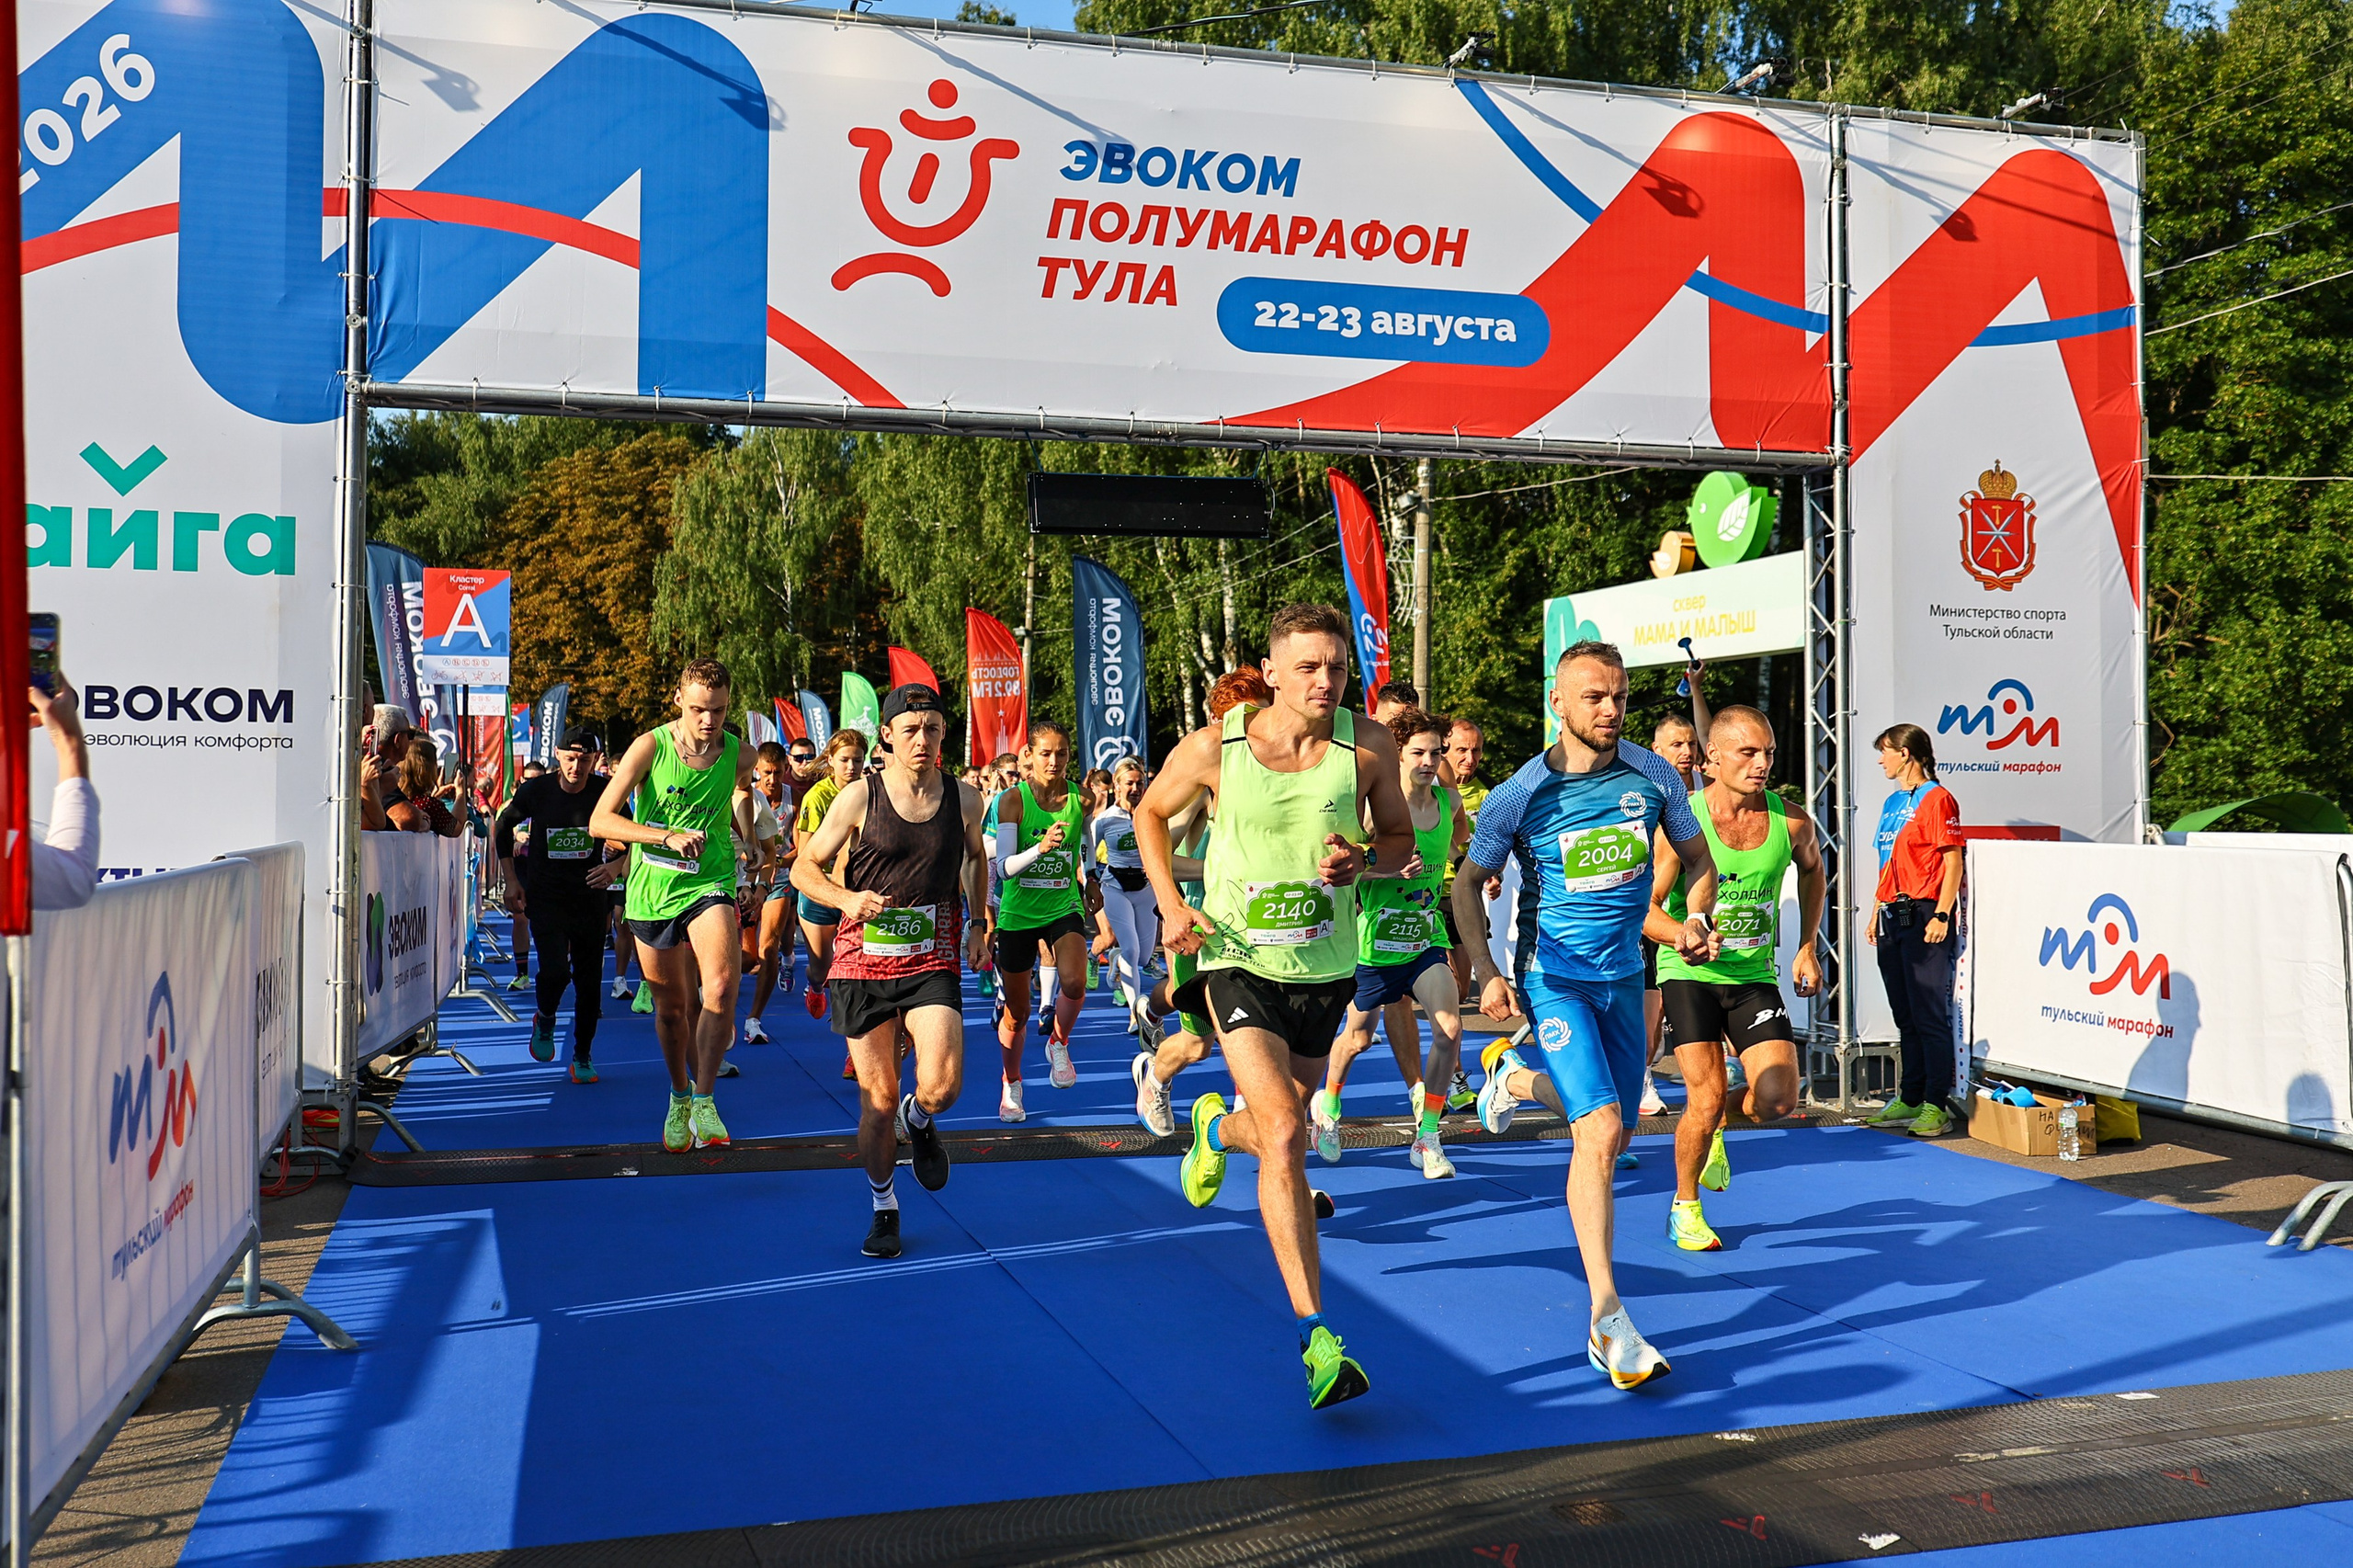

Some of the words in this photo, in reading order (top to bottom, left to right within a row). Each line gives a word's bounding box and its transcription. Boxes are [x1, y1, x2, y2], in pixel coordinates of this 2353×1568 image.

[1060, 140, 1302, 199] ЭВОКОМ
[1046, 198, 1470, 268] ПОЛУМАРАФОН
[1037, 256, 1179, 308] ТУЛА
[1255, 300, 1362, 337] 22-23
[1370, 314, 1518, 345] августа
[449, 574, 485, 585] Кластер
[1929, 605, 2021, 619] Министерство
[2023, 609, 2066, 623] спорта
[1633, 623, 1677, 647] МАМА
[1694, 610, 1756, 638] МАЛЫШ
[1943, 625, 2001, 640] Тульской
[2003, 627, 2054, 640] области
[84, 733, 188, 748] эволюция
[194, 733, 293, 751] комфорта
[539, 701, 553, 768] ЭВОКОМ
[1938, 760, 2000, 774] тульский
[2003, 761, 2062, 773] марафон
[556, 837, 585, 847] 2034
[1578, 843, 1633, 868] 2004
[1029, 861, 1063, 875] 2058
[1597, 864, 1617, 873] СЕРГЕЙ
[1262, 900, 1316, 920] 2140
[389, 905, 426, 960] ЭВОКОМ
[876, 920, 921, 936] 2186
[1389, 924, 1423, 937] 2115
[1718, 918, 1761, 933] 2071
[2040, 1004, 2105, 1028] тульский
[2107, 1015, 2175, 1040] марафон
[2039, 1110, 2054, 1122] НА
[111, 1206, 163, 1282] тульский
[164, 1177, 194, 1232] марафон
